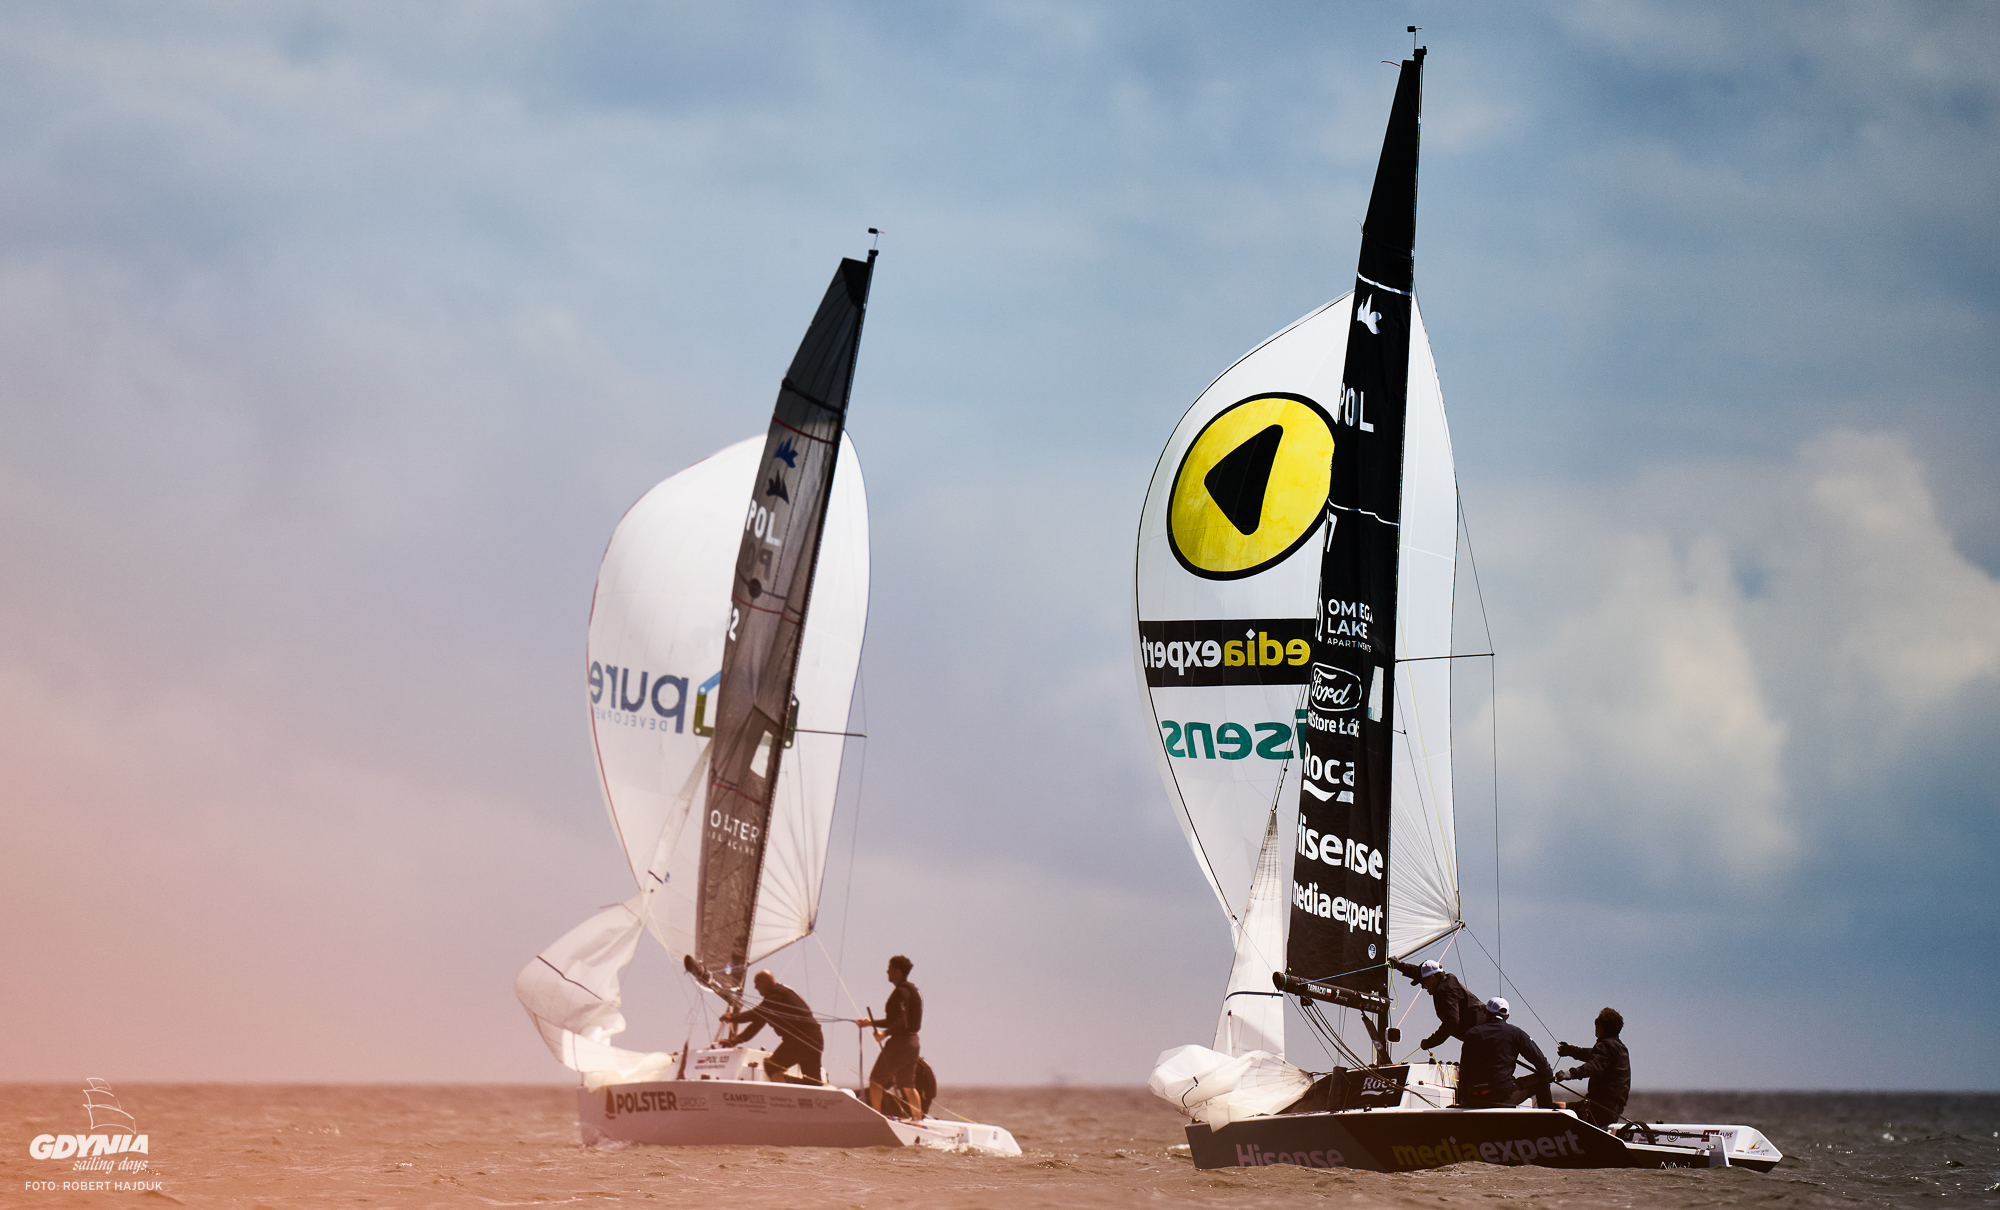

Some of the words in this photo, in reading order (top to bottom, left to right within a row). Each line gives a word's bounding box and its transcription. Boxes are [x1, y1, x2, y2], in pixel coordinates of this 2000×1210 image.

[746, 499, 782, 547] POL
[1323, 509, 1338, 553] 7
[726, 600, 740, 642] 2
[1327, 617, 1368, 640] LAKE
[1311, 667, 1352, 706] Ford
[1303, 741, 1355, 787] Roca
[710, 809, 760, 844] OLTER
[615, 1090, 679, 1114] POLSTER
[1235, 1143, 1345, 1168] Hisense
[1391, 1129, 1586, 1166] mediaexpert
